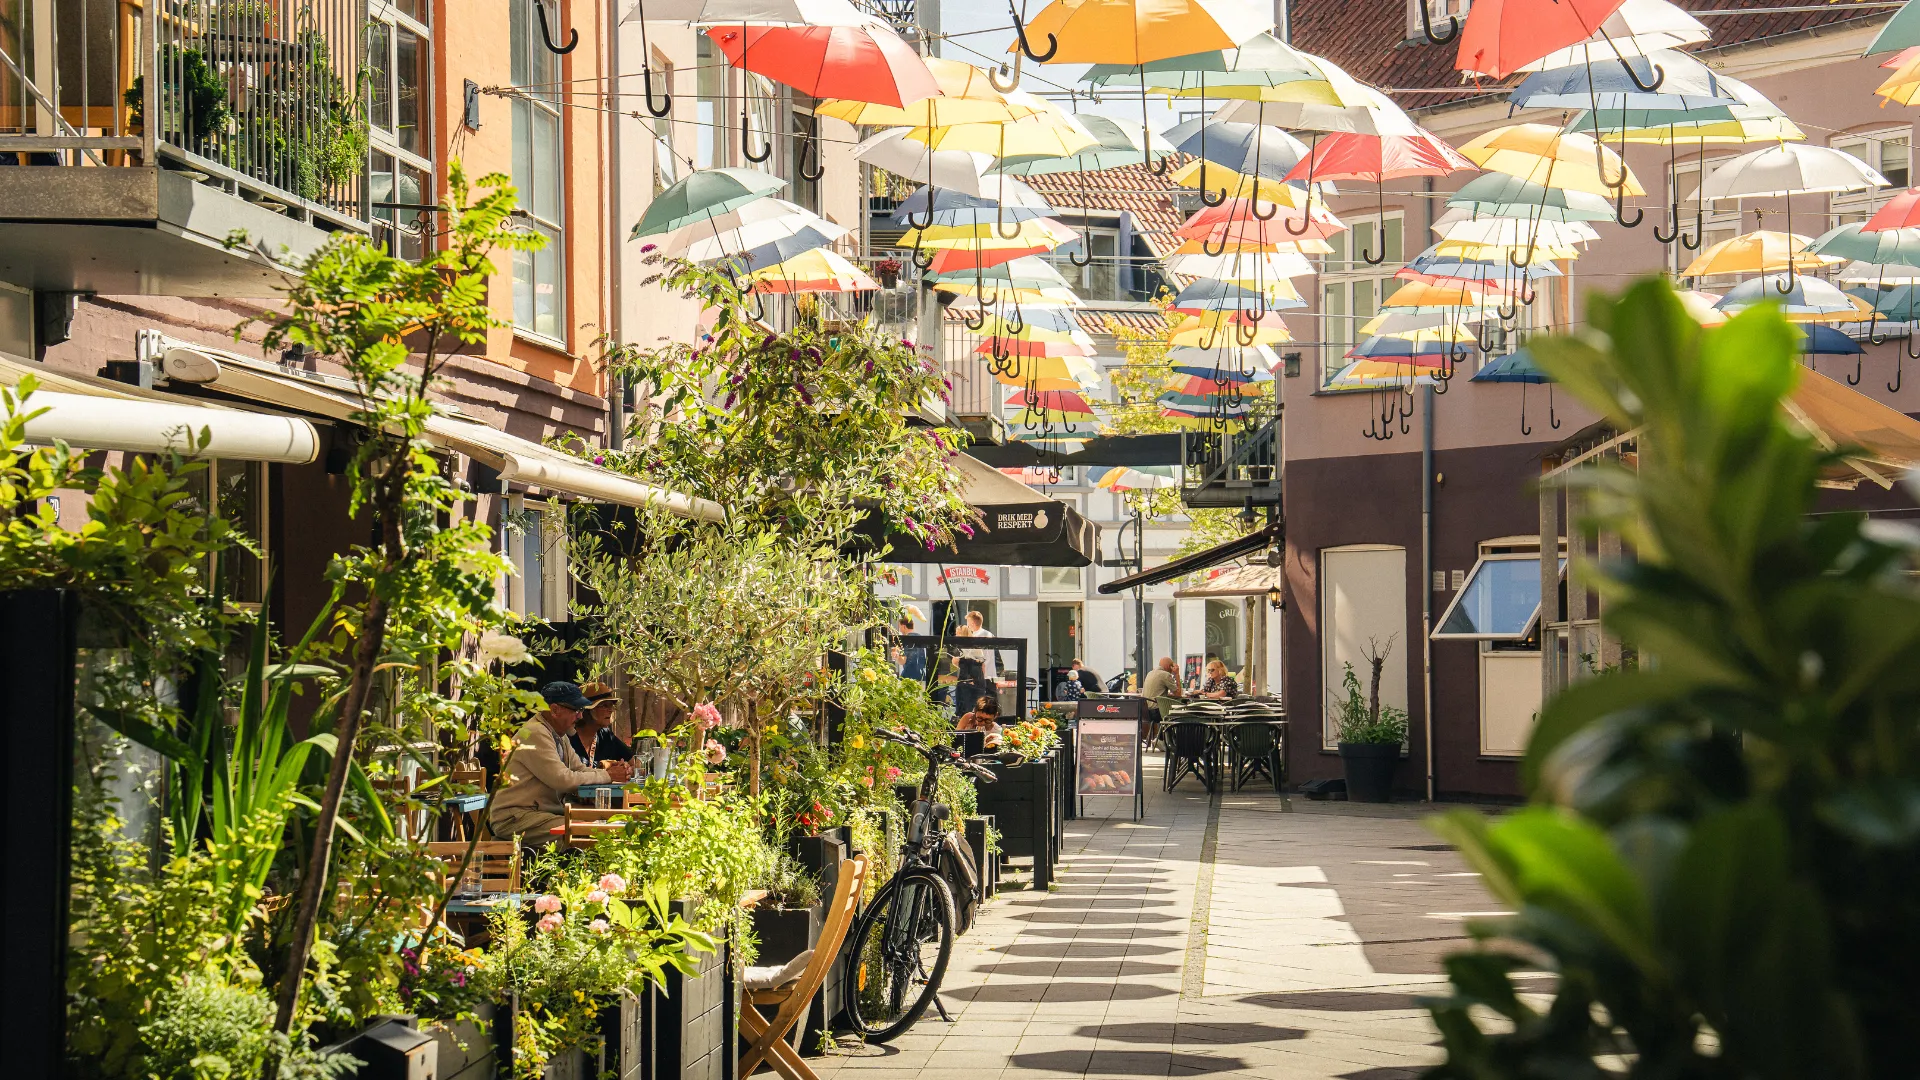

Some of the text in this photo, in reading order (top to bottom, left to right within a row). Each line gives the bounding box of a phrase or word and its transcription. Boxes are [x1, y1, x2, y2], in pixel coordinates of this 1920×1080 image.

[998, 513, 1033, 521] DRIK MED
[998, 520, 1033, 529] RESPEKT
[950, 567, 978, 578] ISTANBUL
